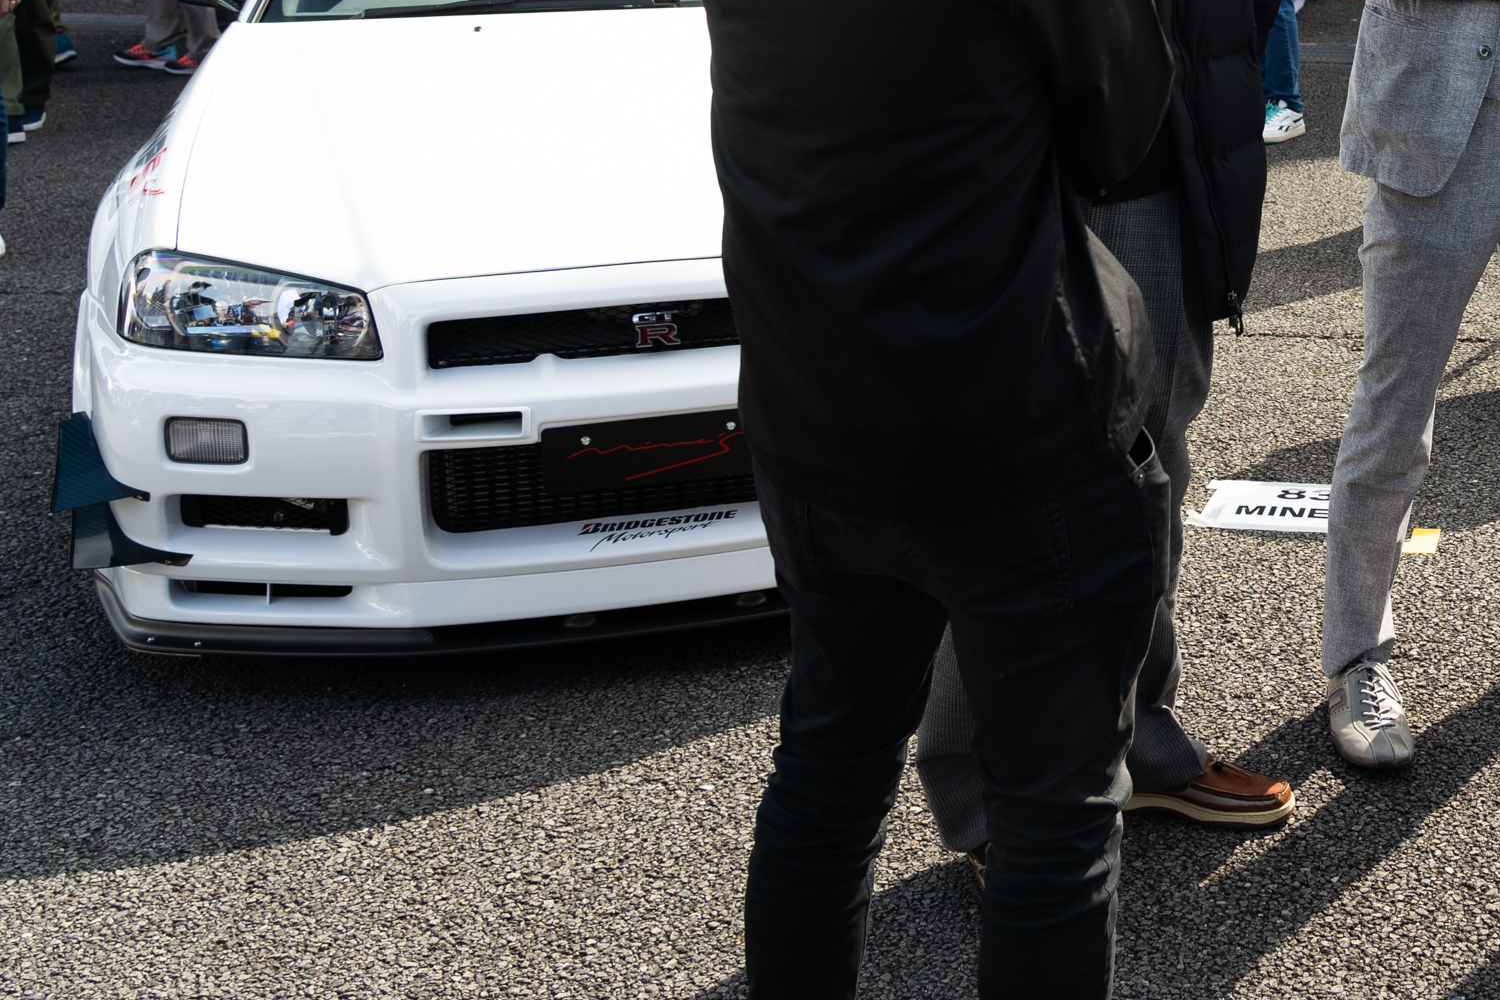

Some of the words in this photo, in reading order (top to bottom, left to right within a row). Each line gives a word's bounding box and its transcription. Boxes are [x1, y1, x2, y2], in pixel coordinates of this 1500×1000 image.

[635, 323, 681, 348] R
[577, 509, 738, 536] BRIDGESTONE
[1235, 505, 1329, 519] MINE
